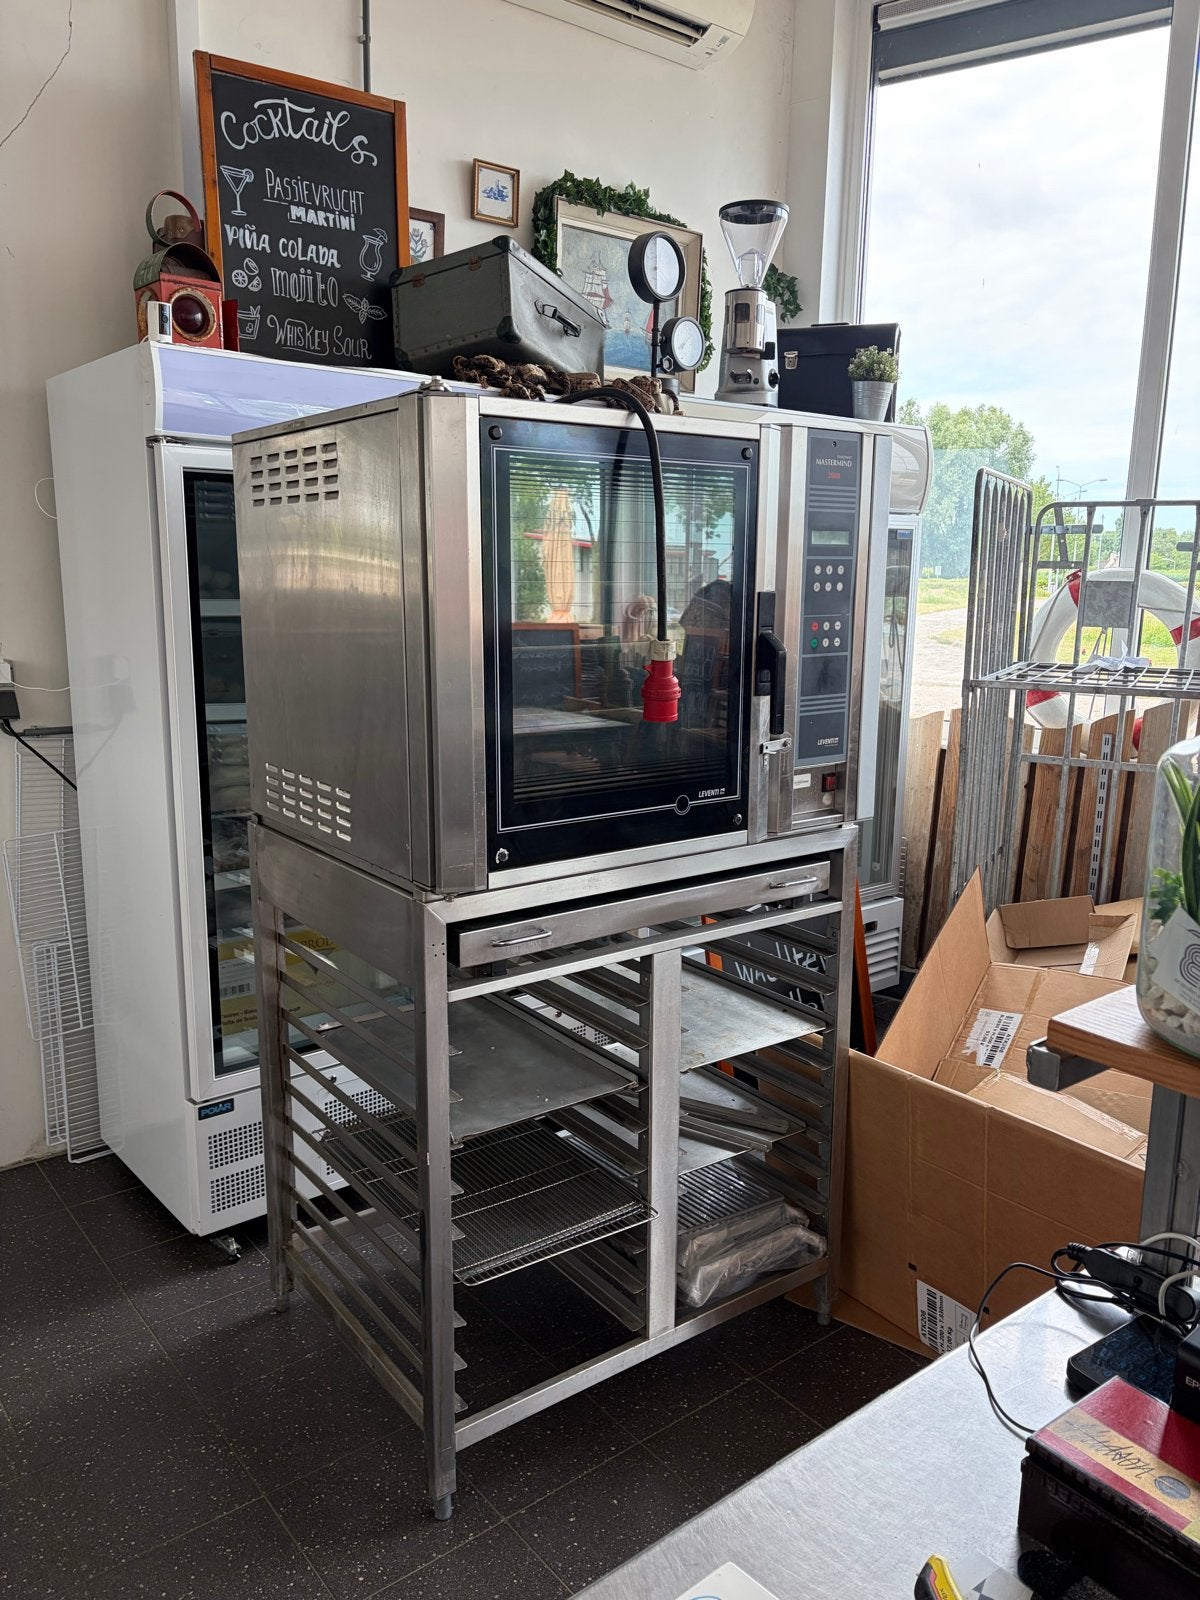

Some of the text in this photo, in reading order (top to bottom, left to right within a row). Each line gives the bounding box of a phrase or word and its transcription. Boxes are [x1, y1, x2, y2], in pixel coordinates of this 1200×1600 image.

[221, 98, 377, 166] Cocktails
[265, 168, 364, 215] PASSIEVRUCHT
[290, 205, 355, 231] MARTINI
[224, 224, 341, 268] PIÑA COLADA
[815, 458, 853, 468] MASTERMIND
[698, 789, 719, 798] LEVENTI
[200, 1103, 232, 1117] POLAR
[920, 1309, 928, 1339] ATK208
[1185, 1375, 1200, 1390] EP
